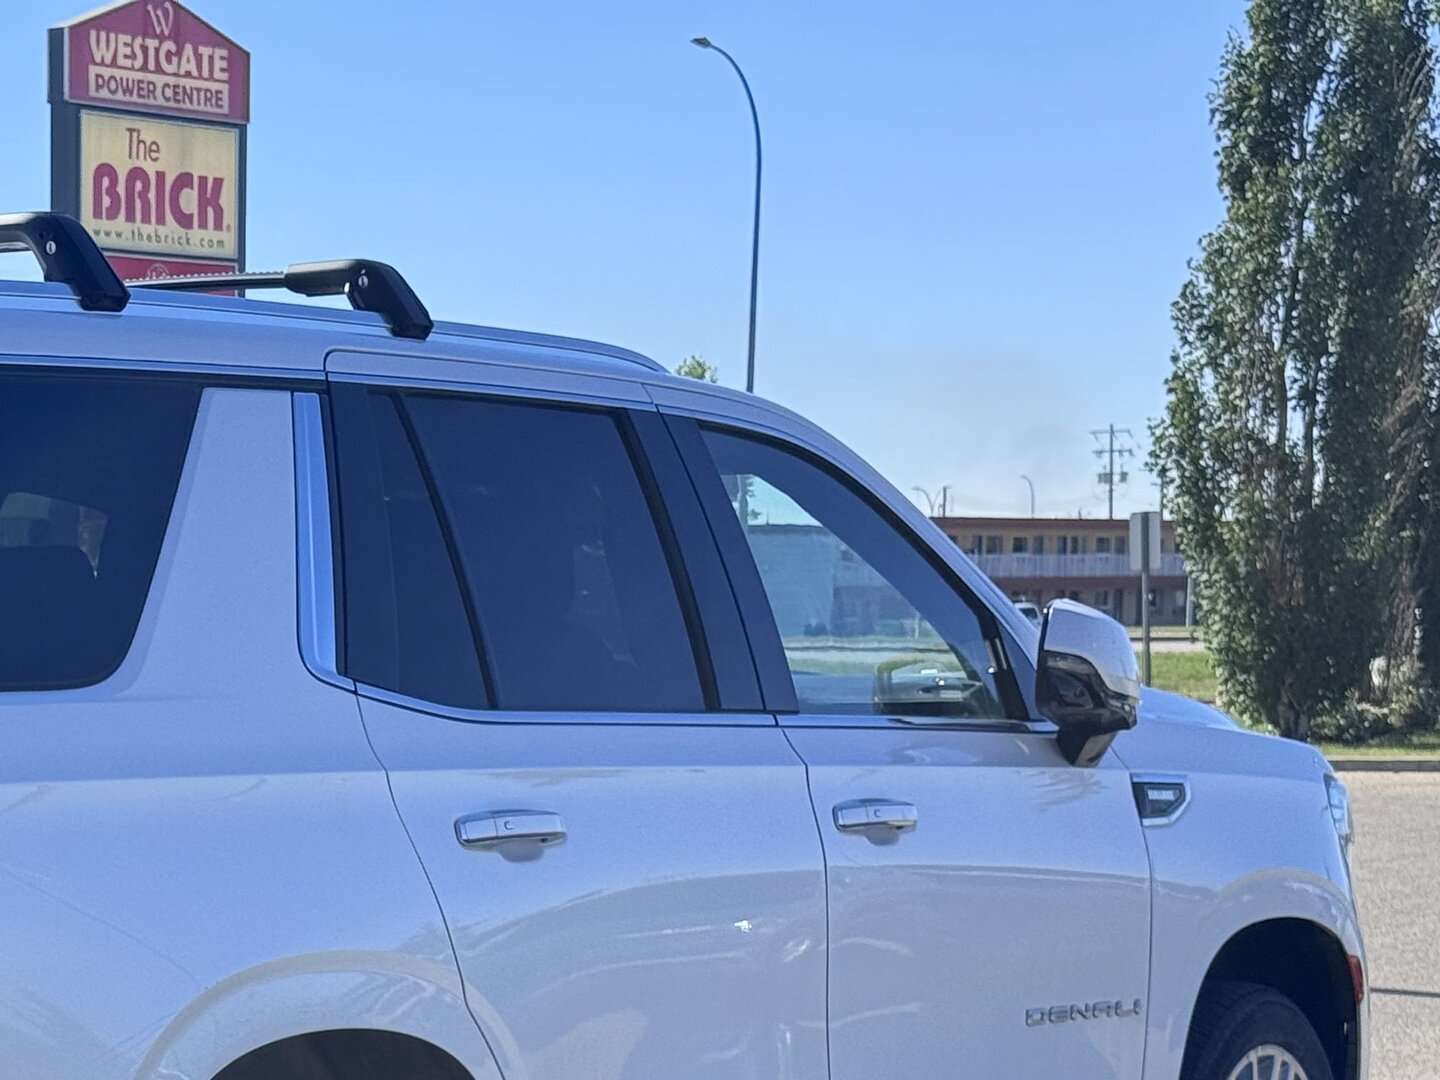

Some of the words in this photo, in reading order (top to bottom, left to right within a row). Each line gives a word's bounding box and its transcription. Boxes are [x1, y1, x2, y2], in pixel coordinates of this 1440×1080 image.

[89, 29, 229, 80] WESTGATE
[94, 73, 158, 101] POWER
[161, 82, 225, 110] CENTRE
[125, 127, 161, 163] The
[92, 162, 225, 232] BRICK
[92, 226, 226, 250] www.thebrick.com
[1024, 998, 1142, 1028] DENALI
